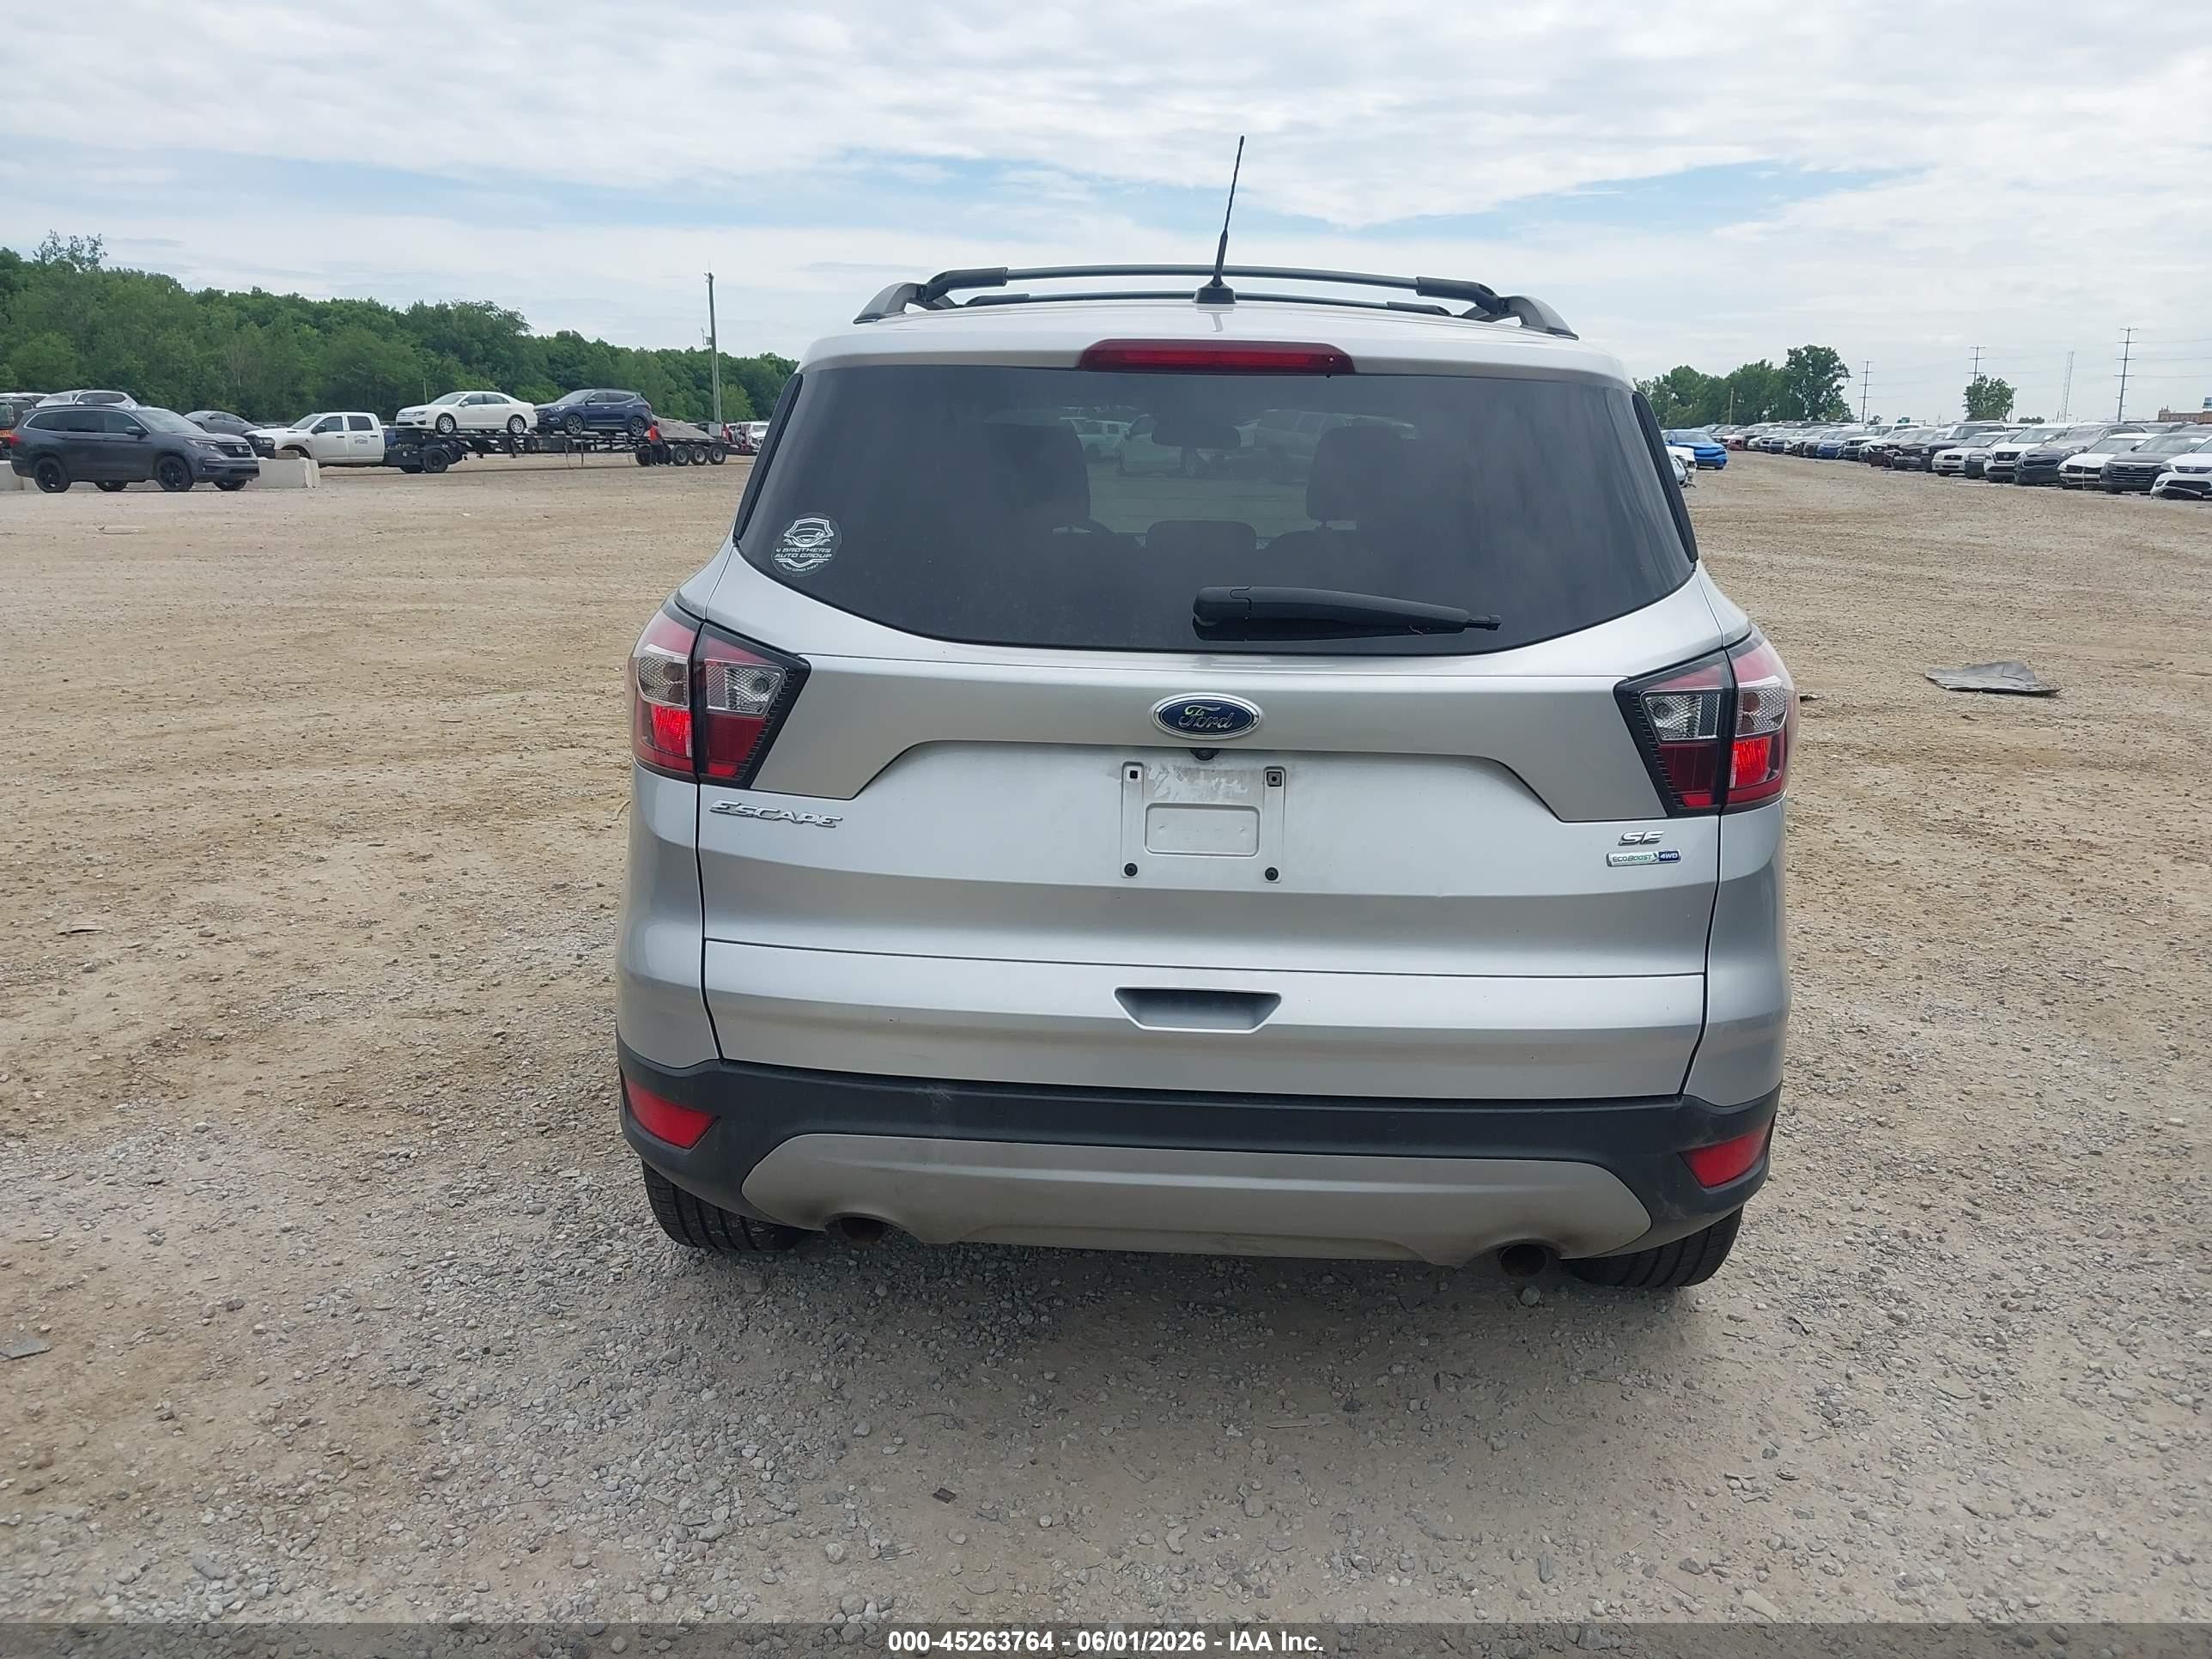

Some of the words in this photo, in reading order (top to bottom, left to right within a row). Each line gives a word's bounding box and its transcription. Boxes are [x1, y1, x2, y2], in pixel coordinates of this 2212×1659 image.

[1178, 704, 1235, 728] Ford
[708, 799, 843, 829] ESCAPE
[1618, 830, 1664, 846] SE
